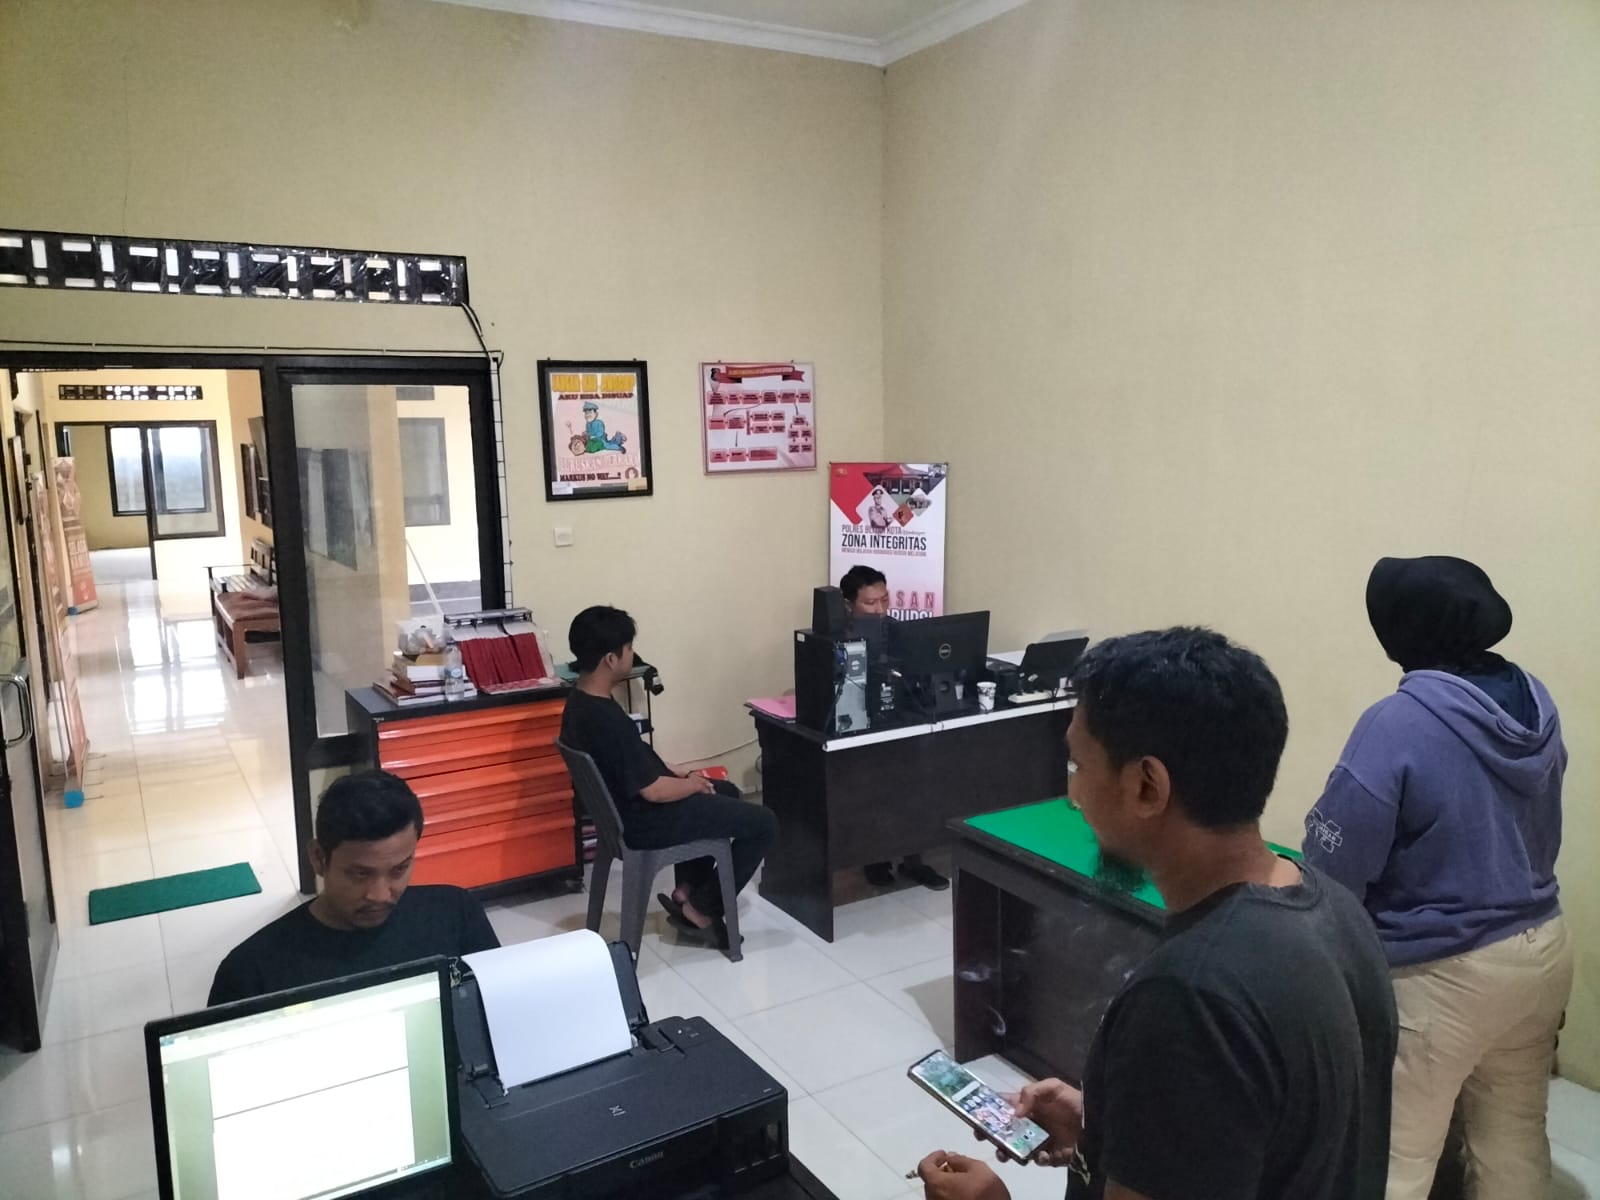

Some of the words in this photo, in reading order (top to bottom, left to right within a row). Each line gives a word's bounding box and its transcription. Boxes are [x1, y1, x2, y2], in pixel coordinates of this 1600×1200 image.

[841, 533, 867, 548] ZONA
[870, 534, 927, 551] INTEGRITAS
[893, 590, 935, 608] SAN
[629, 1151, 664, 1169] Canon
